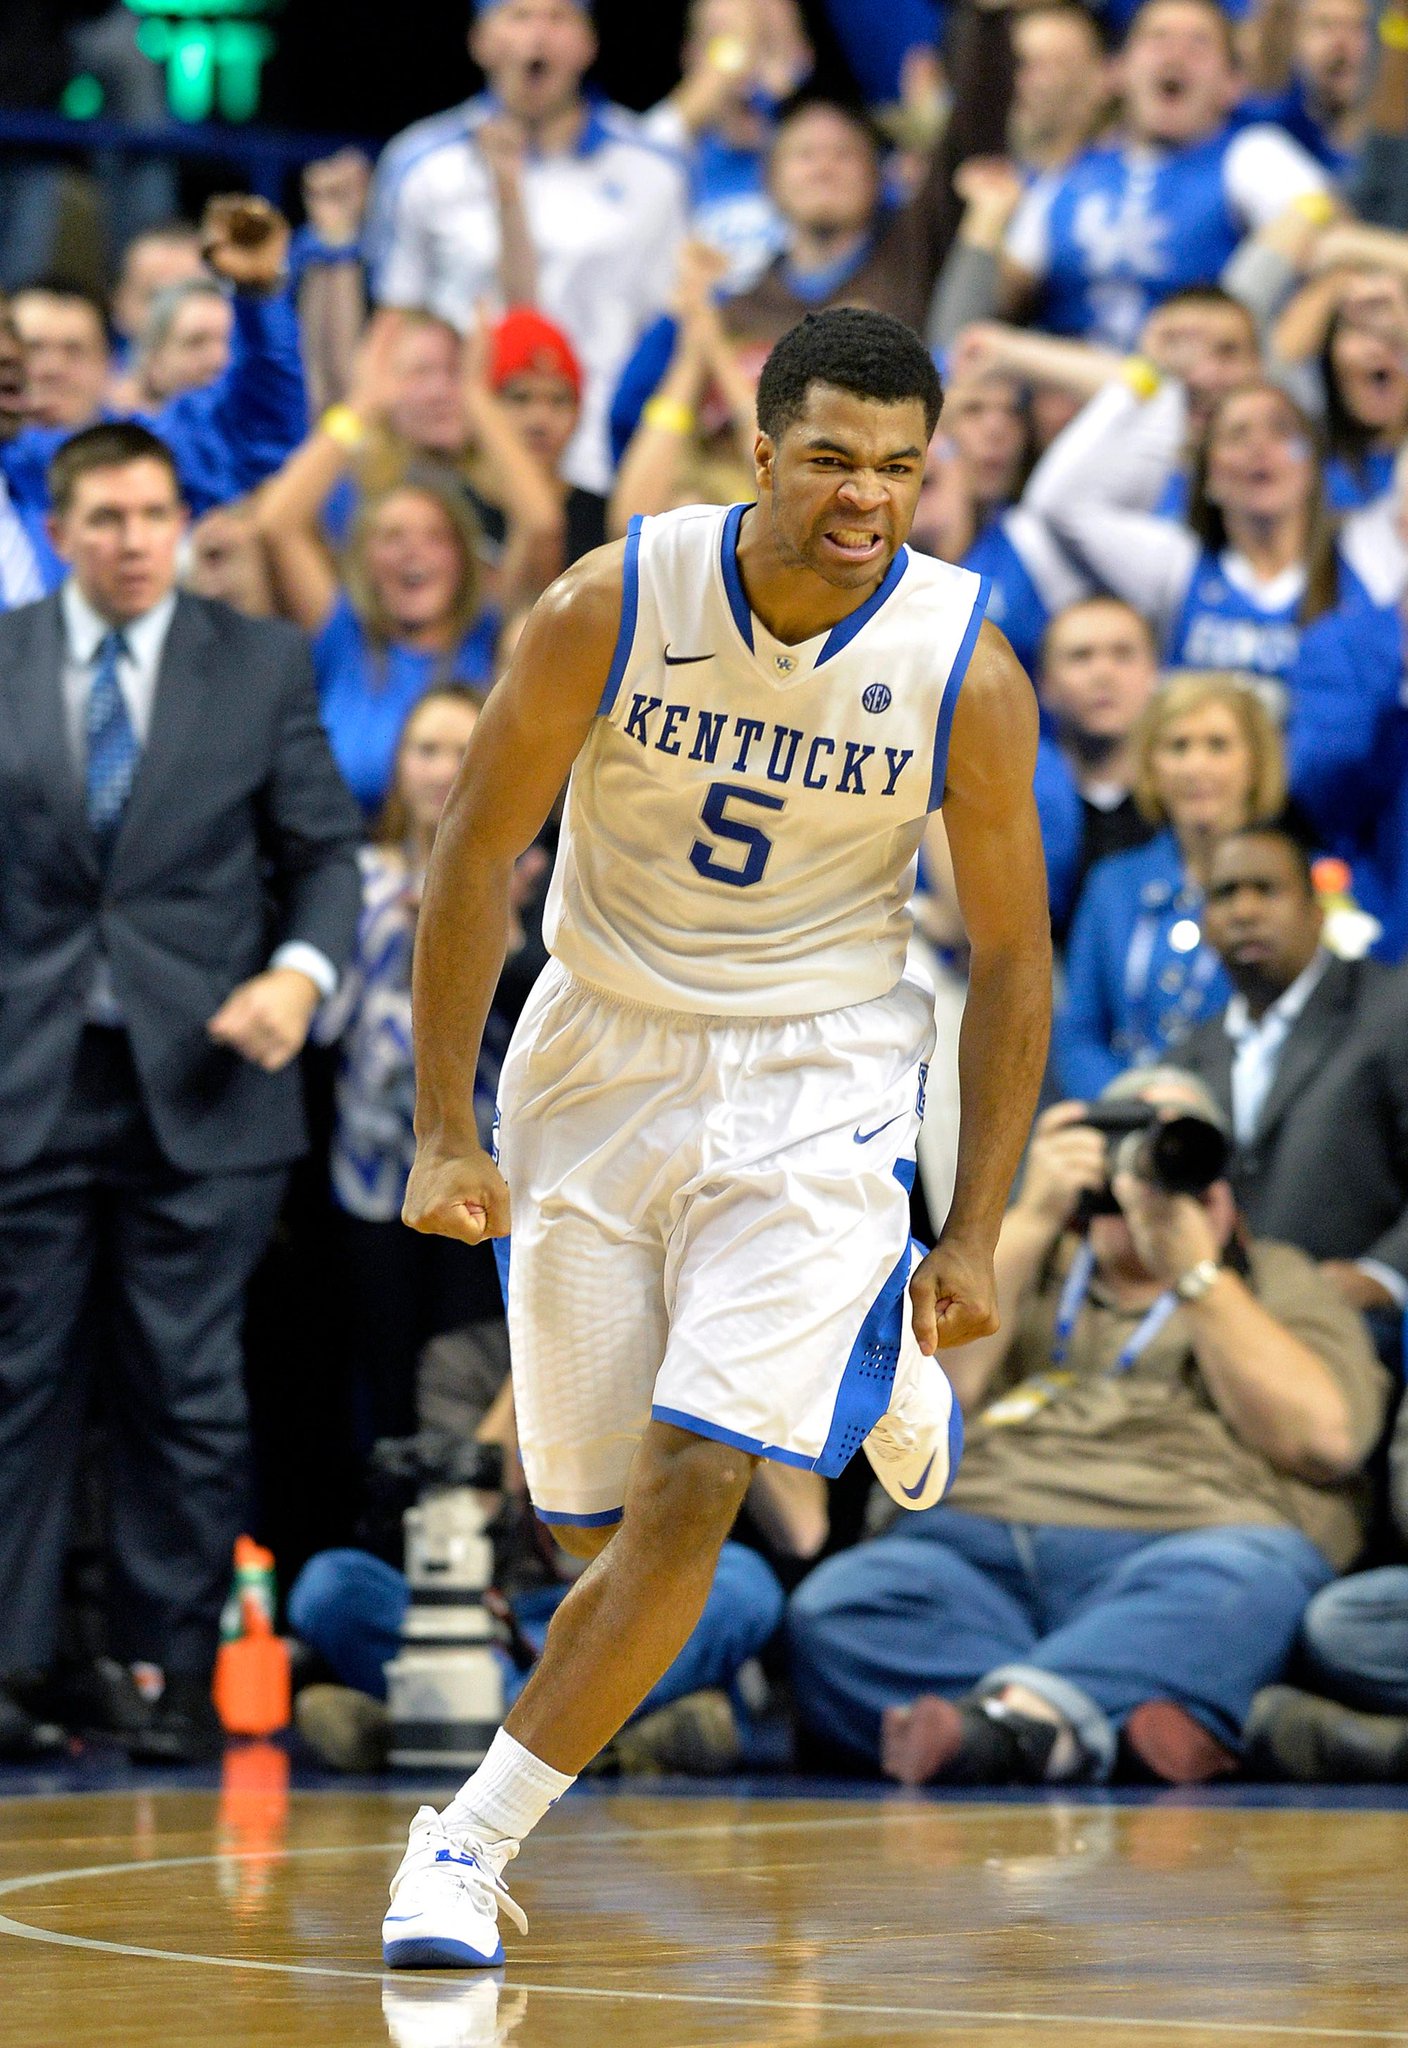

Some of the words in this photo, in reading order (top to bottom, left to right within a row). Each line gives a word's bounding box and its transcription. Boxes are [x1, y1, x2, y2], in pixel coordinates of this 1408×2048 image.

[624, 693, 914, 796] KENTUCKY
[864, 685, 891, 712] SEC
[687, 781, 788, 888] 5
